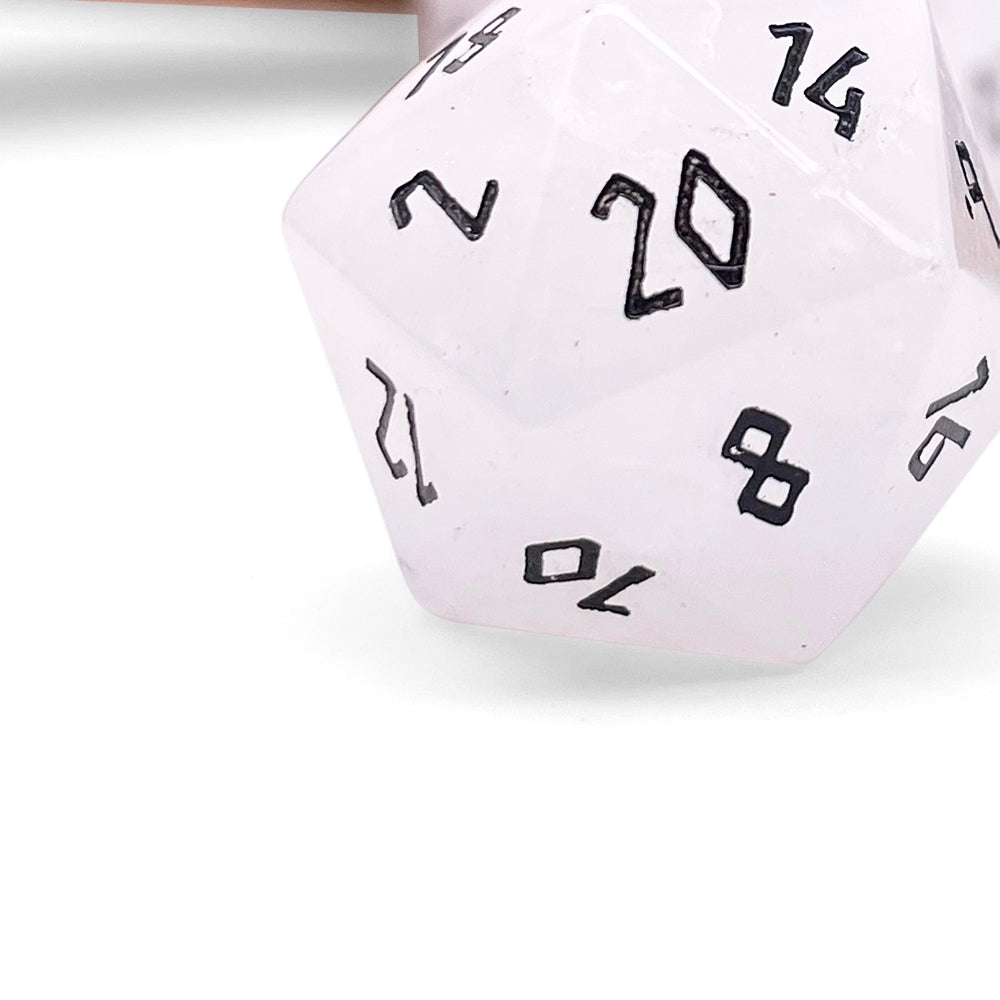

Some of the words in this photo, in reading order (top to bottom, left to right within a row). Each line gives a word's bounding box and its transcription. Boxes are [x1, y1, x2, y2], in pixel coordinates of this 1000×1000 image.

[404, 6, 521, 100] 18
[768, 21, 870, 142] 14
[388, 169, 500, 242] 2
[589, 148, 751, 321] 20
[720, 405, 811, 527] 8
